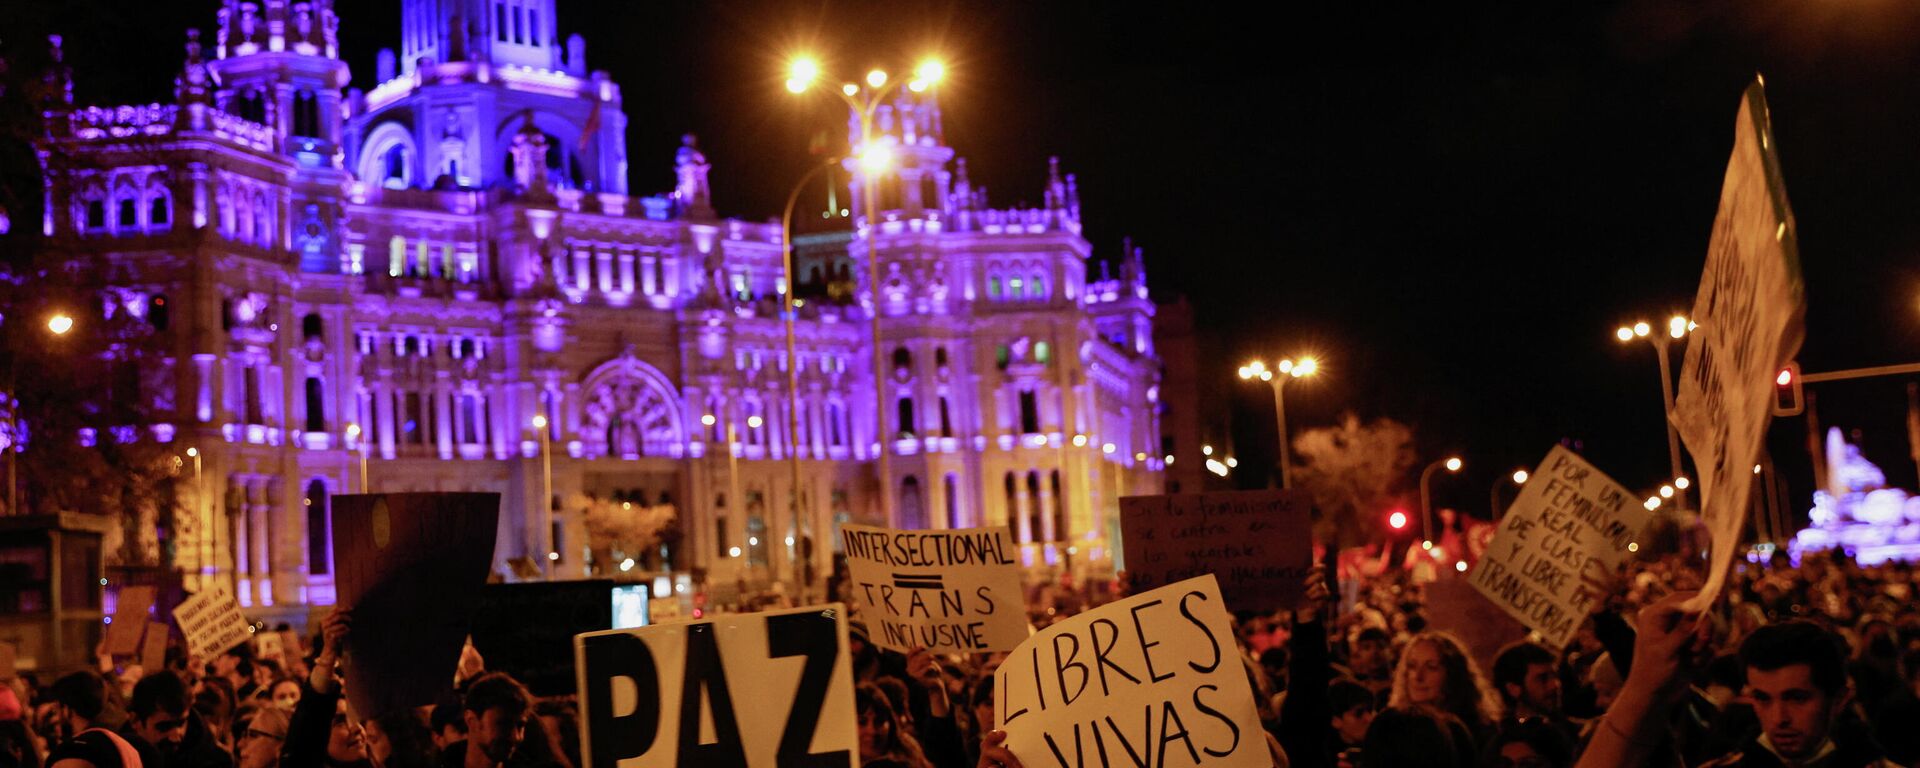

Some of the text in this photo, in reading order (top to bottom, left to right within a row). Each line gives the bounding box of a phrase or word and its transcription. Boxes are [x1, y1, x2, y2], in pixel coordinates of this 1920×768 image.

[1164, 495, 1185, 517] tu
[1193, 495, 1297, 524] feminismo
[1542, 478, 1634, 552] FEMINISMO
[1551, 455, 1625, 513] POR UN
[843, 529, 1014, 567] INTERSECTIONAL
[1168, 521, 1231, 540] centra
[1507, 514, 1599, 584] DE CLASE
[1538, 506, 1585, 545] REAL
[860, 582, 994, 618] TRANS
[1478, 558, 1573, 642] TRANSFOBIA
[1507, 542, 1596, 614] Y LIBRE DE
[881, 619, 988, 650] INCLUSIVE
[1003, 591, 1221, 706] LIBRES
[582, 610, 851, 768] PAZ
[1044, 684, 1240, 768] VIVAS
